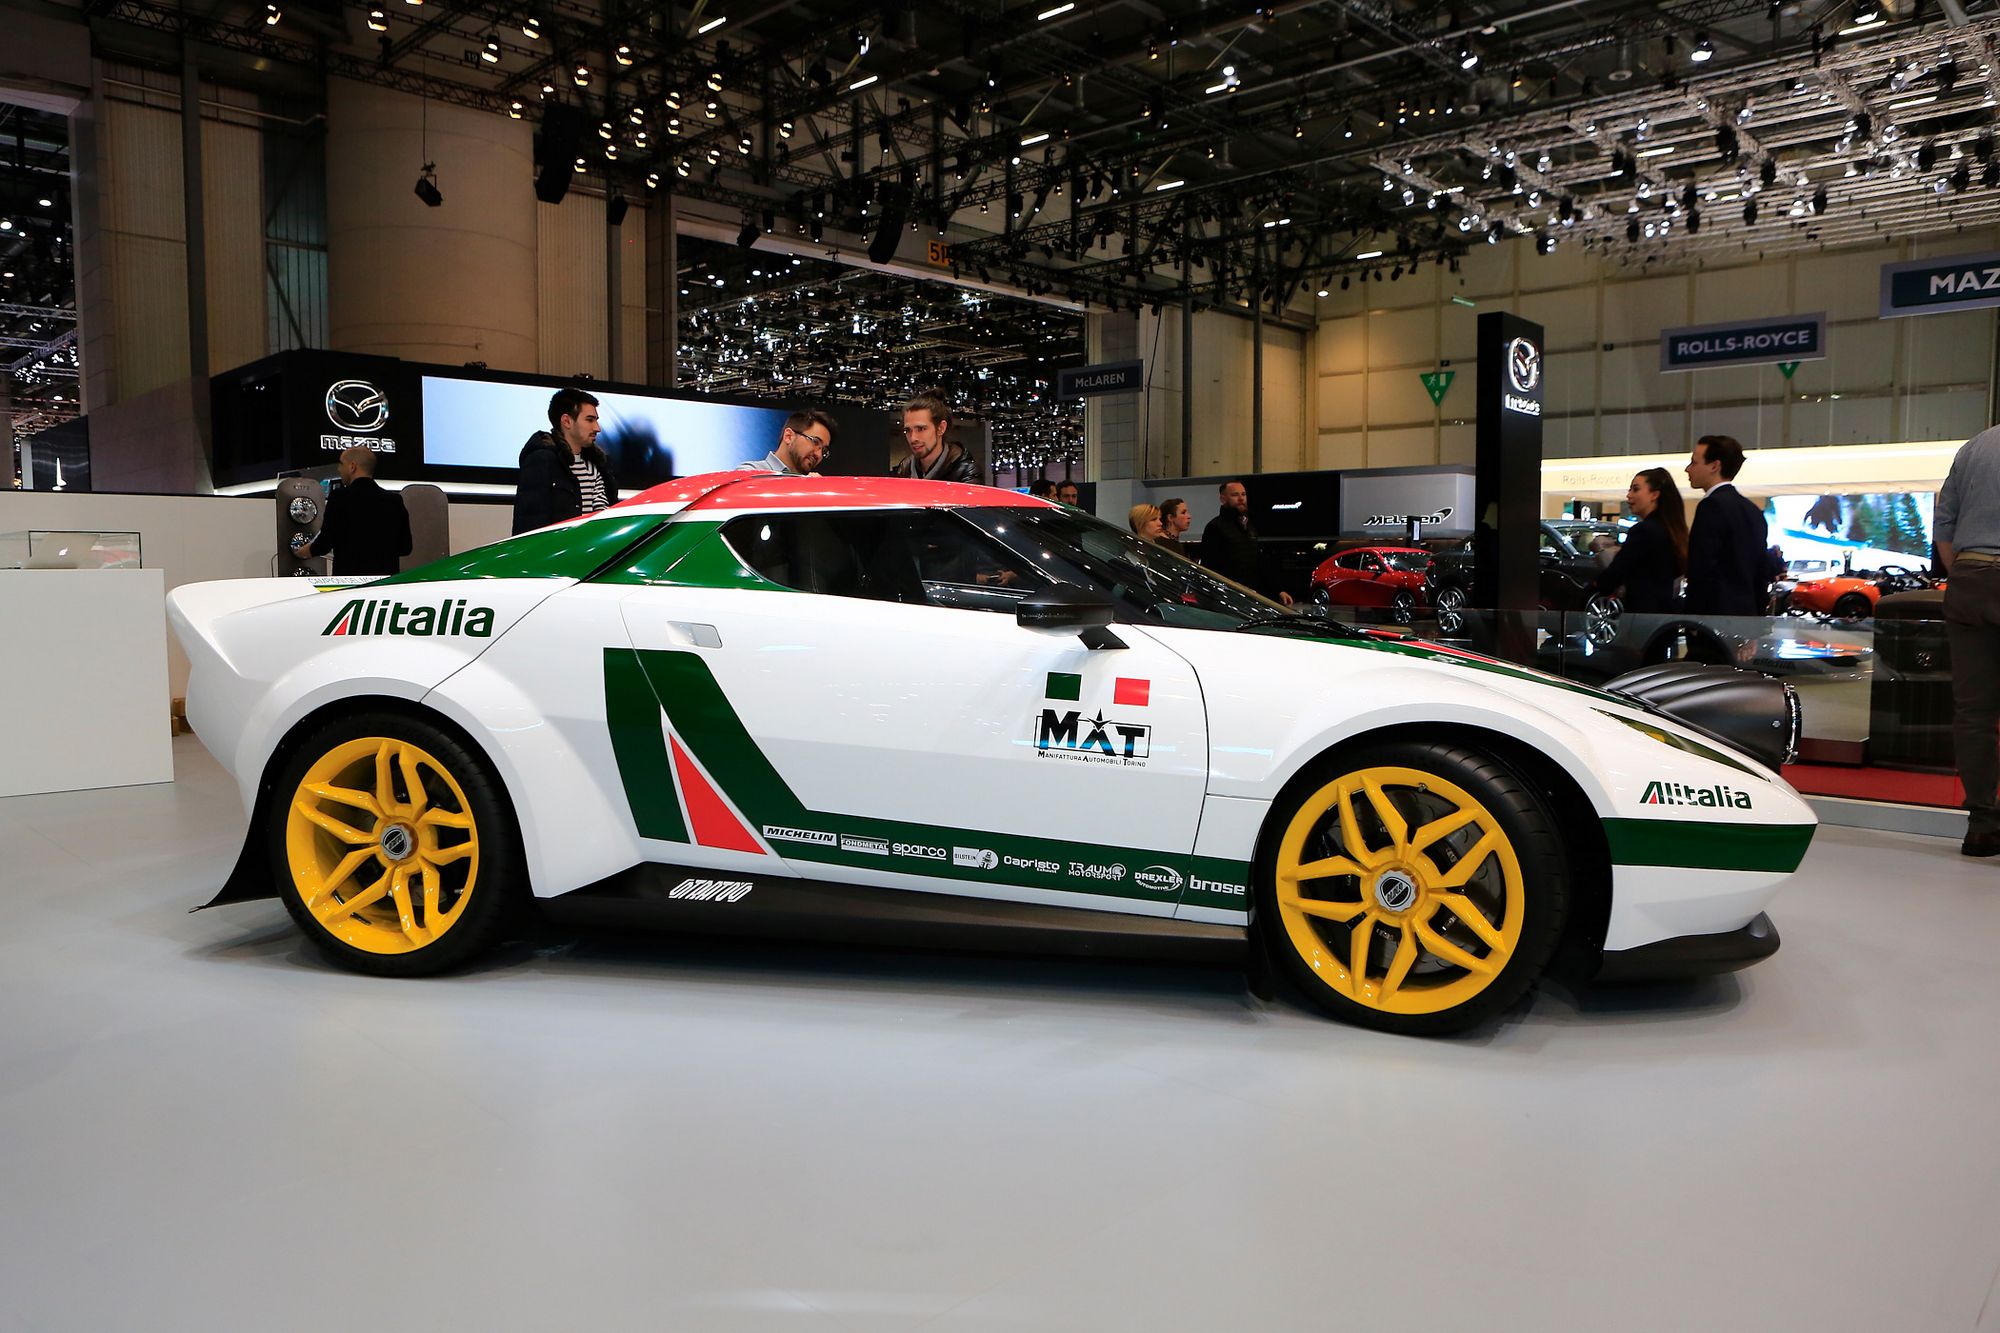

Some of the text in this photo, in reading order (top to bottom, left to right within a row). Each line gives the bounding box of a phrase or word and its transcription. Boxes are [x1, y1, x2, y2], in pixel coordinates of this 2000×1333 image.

[1677, 330, 1809, 355] ROLLS-ROYCE
[1075, 372, 1125, 388] McLAREN
[321, 599, 495, 637] Alitalia
[1038, 708, 1146, 758] MAT
[1640, 781, 1753, 809] Alitalia
[767, 827, 834, 842] MICHELIN
[892, 843, 947, 858] sparco
[954, 853, 976, 861] BILSTEIN
[1068, 869, 1121, 881] MOTORSPORT
[1134, 872, 1183, 884] DREXLER
[1189, 875, 1246, 895] brose
